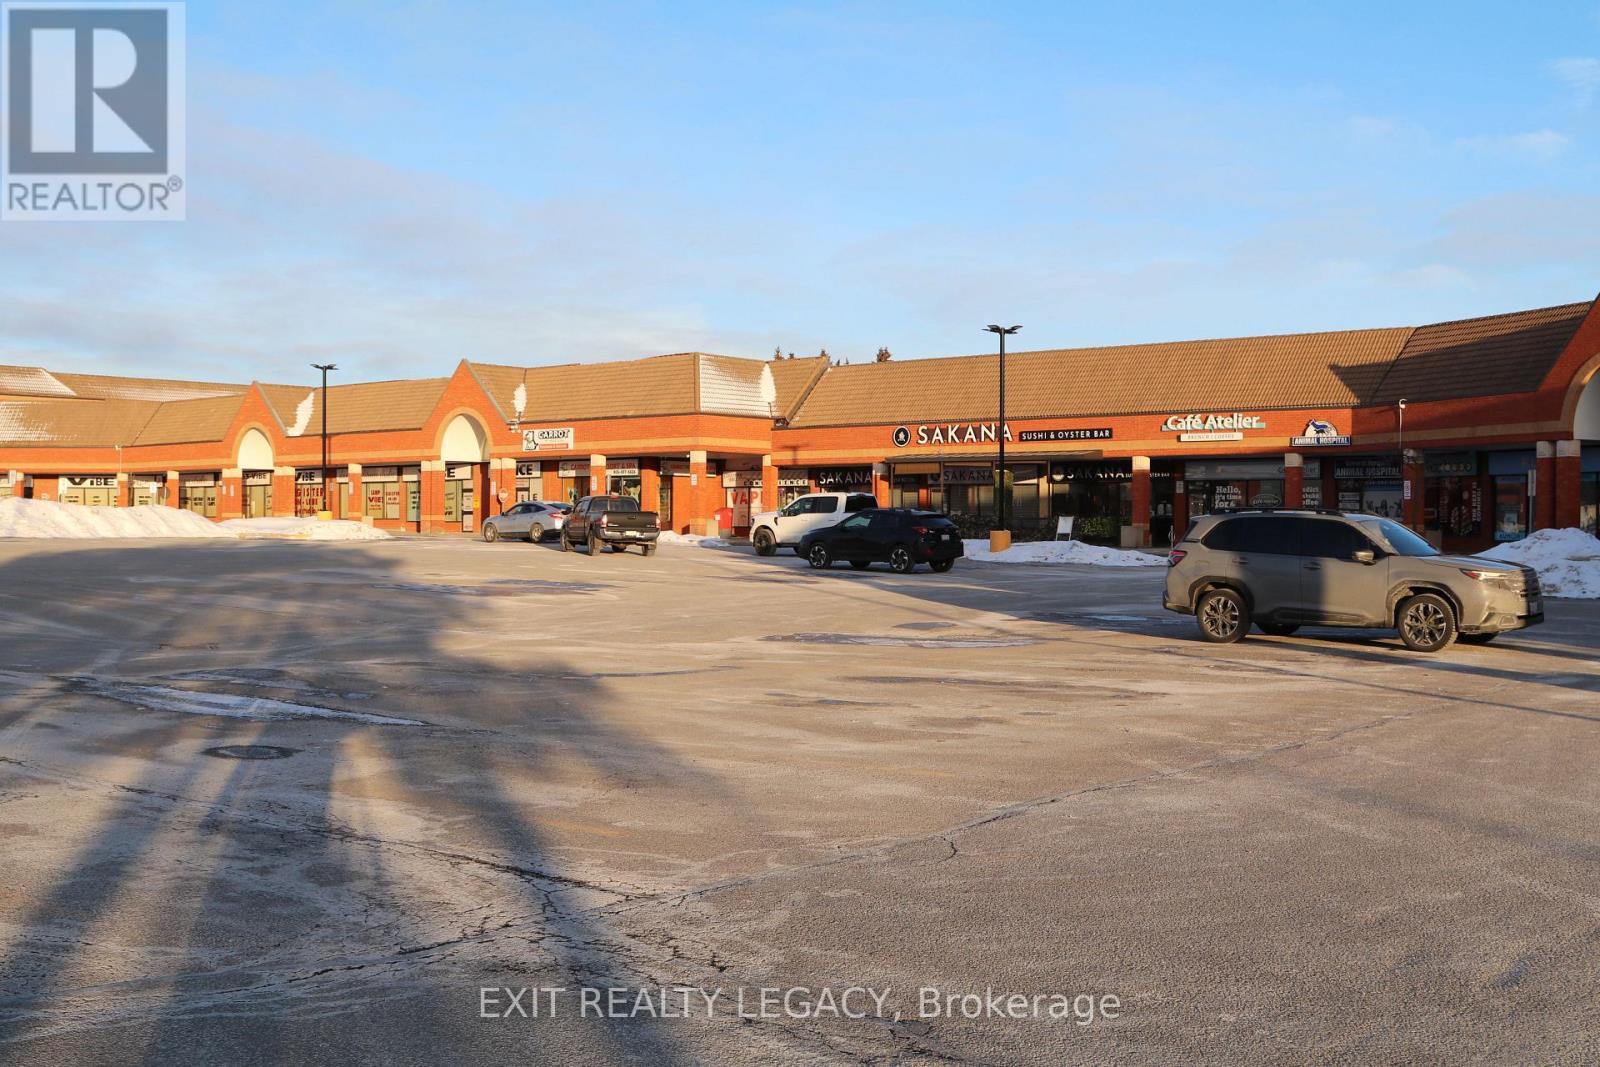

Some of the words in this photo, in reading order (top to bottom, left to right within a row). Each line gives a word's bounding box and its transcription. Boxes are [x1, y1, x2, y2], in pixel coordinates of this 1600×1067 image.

[1167, 413, 1203, 430] Café
[1205, 412, 1260, 429] Atelier
[538, 429, 570, 439] CARROT
[917, 423, 1013, 444] SAKANA
[1022, 432, 1047, 440] SUSHI
[1058, 431, 1091, 439] OYSTER
[1093, 430, 1110, 438] BAR
[1294, 437, 1318, 446] ANIMAL
[1319, 436, 1349, 445] HOSPITAL
[820, 472, 872, 484] SAKANA
[943, 470, 994, 481] SAKANA
[1216, 486, 1241, 494] Hello,
